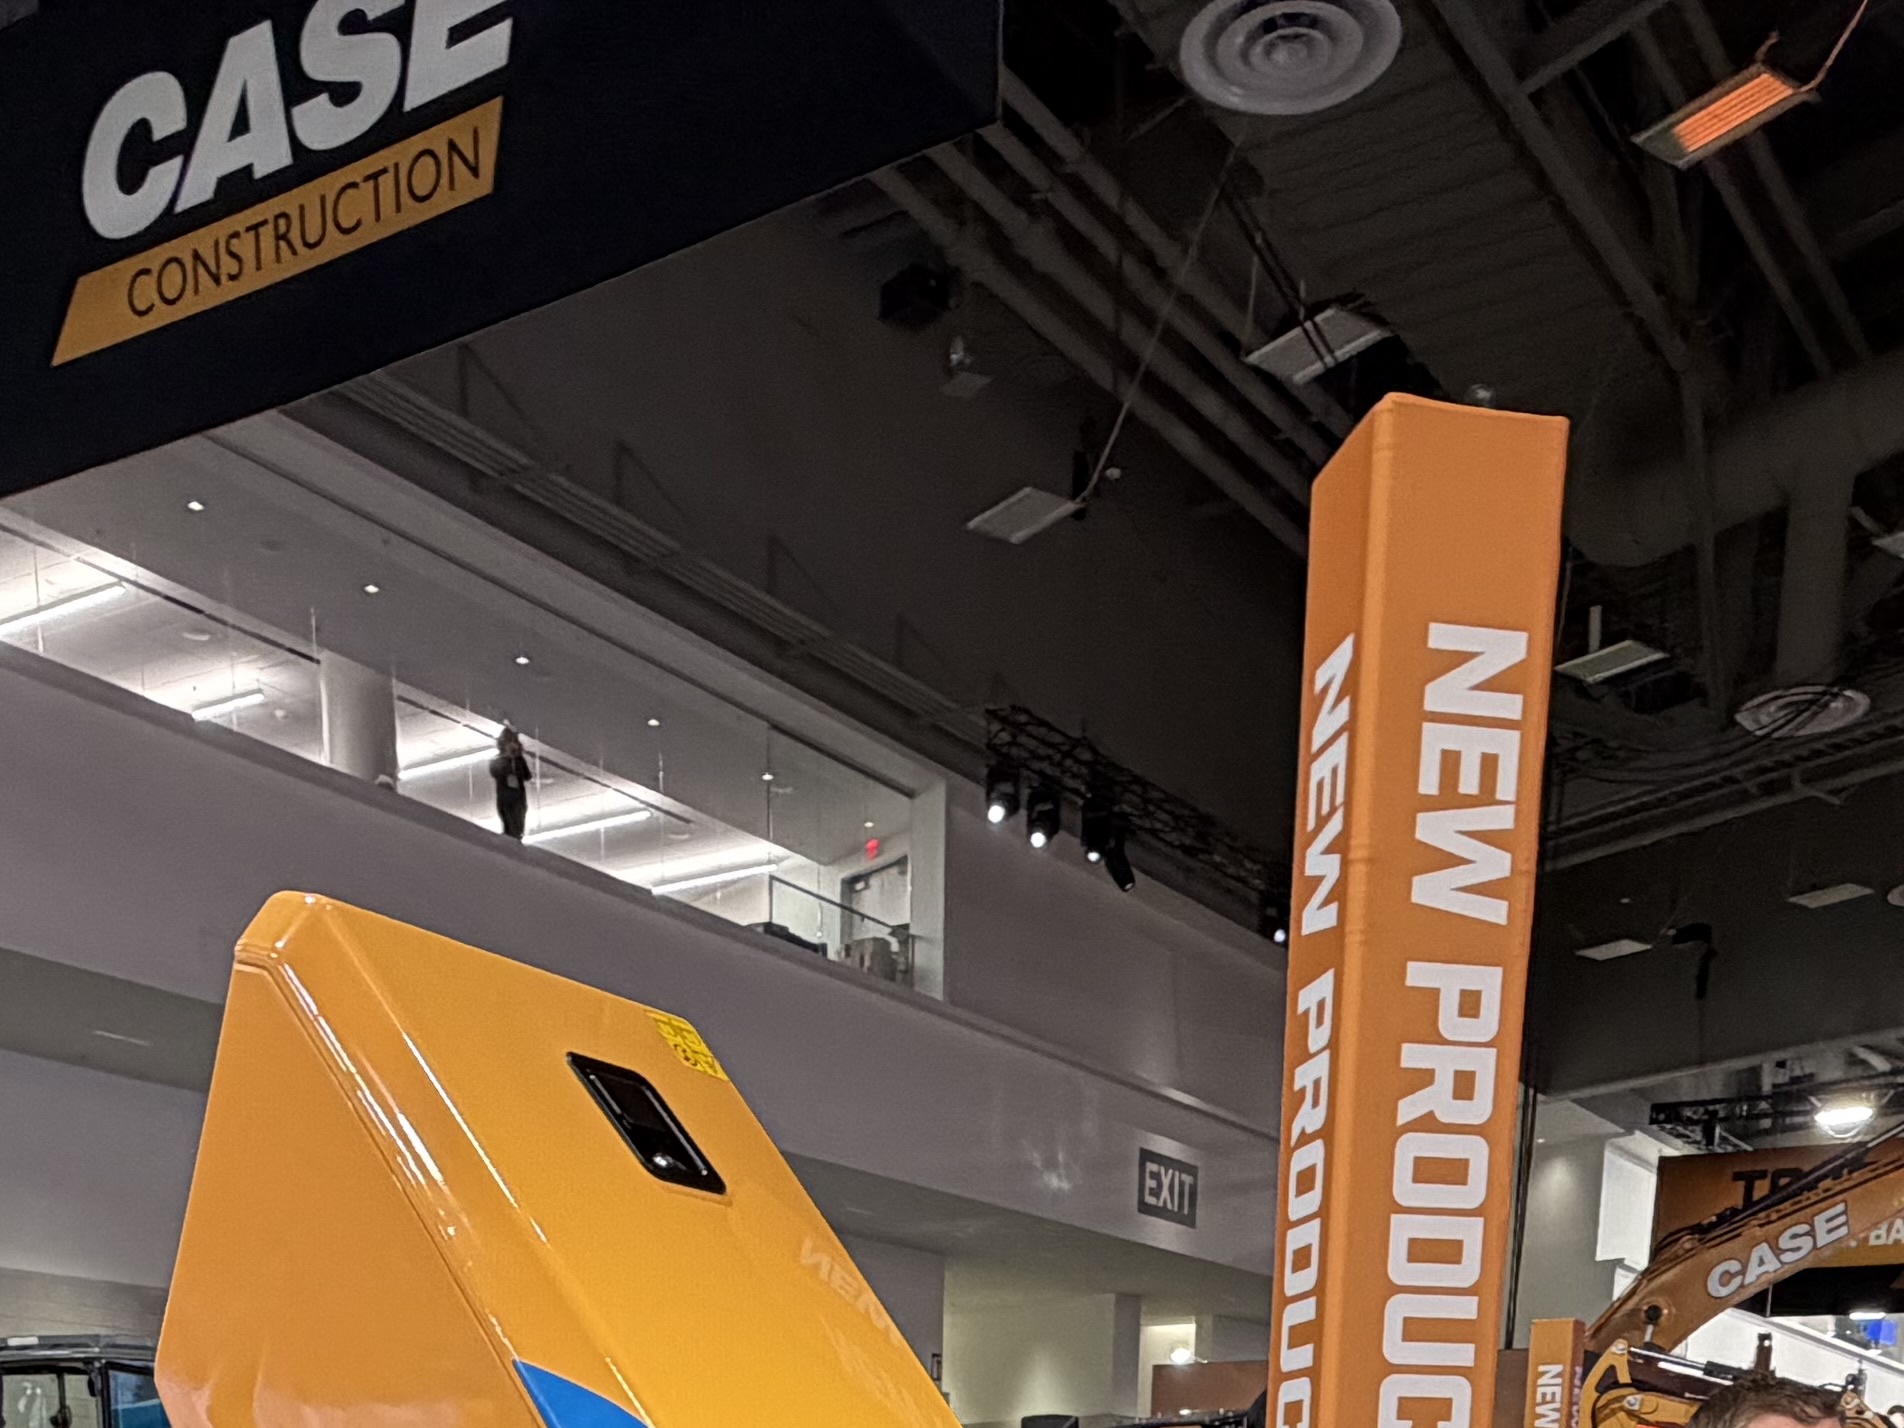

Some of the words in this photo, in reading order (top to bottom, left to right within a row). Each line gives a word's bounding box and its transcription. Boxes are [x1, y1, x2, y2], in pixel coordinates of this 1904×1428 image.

[82, 0, 514, 239] CASE
[126, 126, 480, 318] CONSTRUCTION
[1300, 631, 1355, 937] NEW
[1410, 621, 1529, 926] NEW
[1144, 1160, 1195, 1214] EXIT
[1706, 1200, 1851, 1299] CASE
